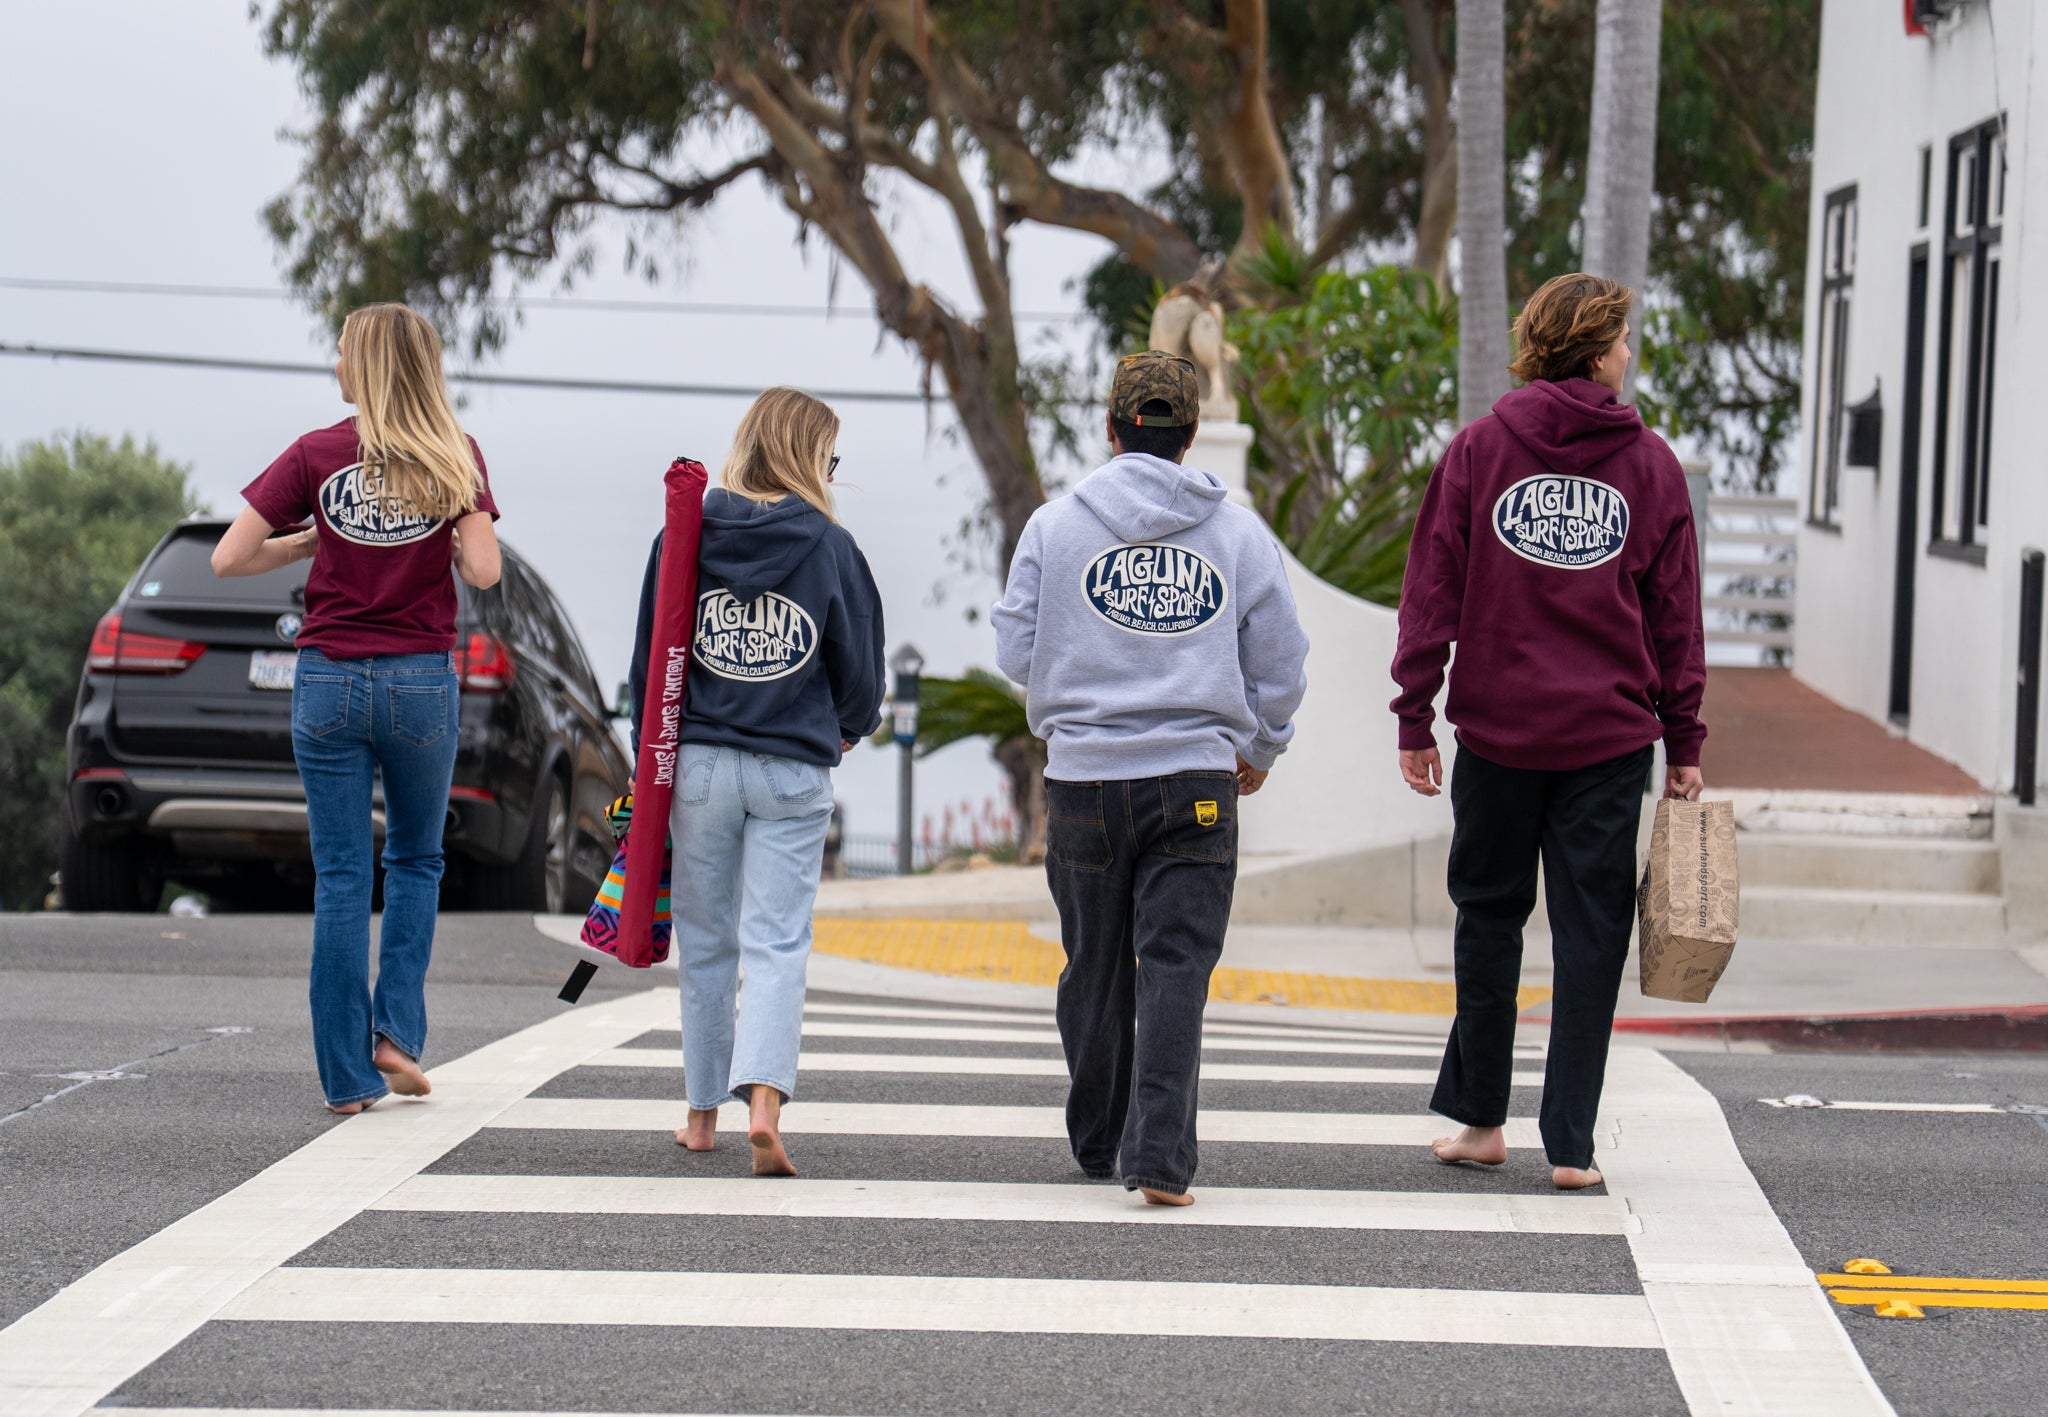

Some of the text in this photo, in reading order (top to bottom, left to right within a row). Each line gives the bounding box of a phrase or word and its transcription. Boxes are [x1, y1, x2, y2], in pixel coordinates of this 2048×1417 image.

[328, 466, 432, 516] LAG
[339, 500, 380, 531] SURF
[1503, 479, 1623, 539] LAGUNA
[365, 530, 389, 542] BEACH,
[389, 524, 428, 541] CALIFORNIA
[1514, 517, 1615, 552] SURF SPORT
[1543, 550, 1569, 565] BEACH,
[1568, 547, 1609, 564] CALIFORNIA
[1092, 547, 1216, 609] LAGUNA
[1104, 584, 1205, 619] SURF SPORT
[1131, 618, 1157, 632] BEACH,
[1157, 617, 1198, 632] CALIFORNIA
[700, 630, 796, 664] SURF SPORT
[725, 664, 750, 677] BEACH,
[749, 660, 789, 676] CALIFORNIA
[653, 646, 686, 788] LAGUNA SURF SPORT
[1698, 811, 1709, 928] www.surfandsport.com
